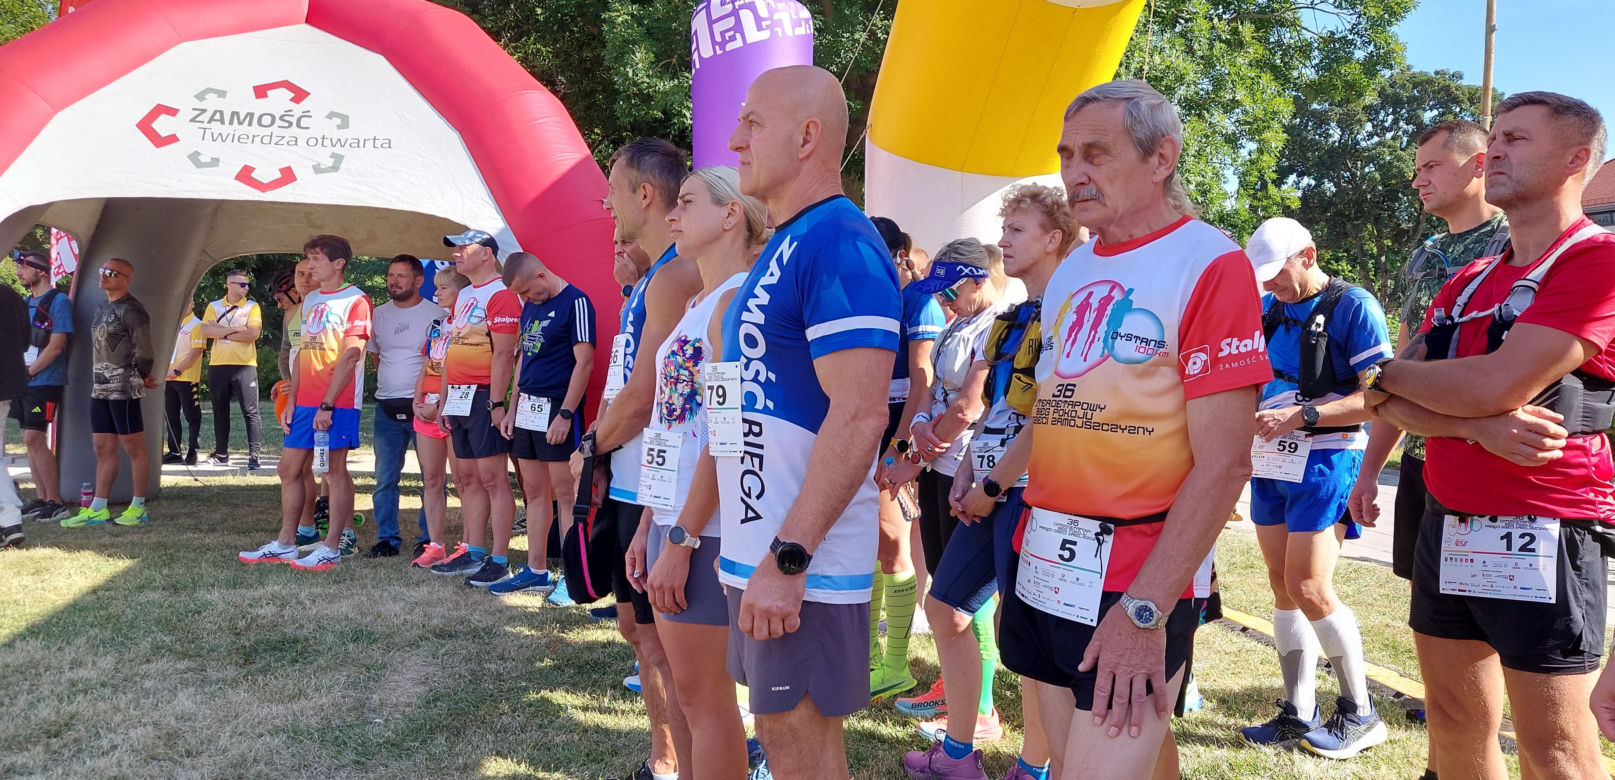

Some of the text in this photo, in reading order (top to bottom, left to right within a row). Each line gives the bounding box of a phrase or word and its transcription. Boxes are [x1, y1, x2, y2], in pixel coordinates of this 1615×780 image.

[189, 107, 312, 130] ZAMOŚĆ
[197, 127, 392, 149] Twierdza otwarta
[739, 234, 798, 412] ZAMOŚĆ
[1111, 331, 1168, 350] DYSTANS:
[1219, 355, 1257, 370] ZAMOŚĆ
[459, 391, 470, 399] 28
[707, 384, 727, 407] 79
[1052, 383, 1077, 399] 36
[530, 403, 544, 413] 65
[1052, 408, 1094, 421] POKOJU
[1051, 416, 1155, 436] ZAMOJSZCZYZNY
[1277, 440, 1299, 454] 59
[646, 447, 667, 467] 55
[977, 454, 996, 469] 78
[740, 417, 766, 525] BIEGA
[1058, 538, 1078, 562] 5
[1500, 531, 1537, 553] 12
[911, 699, 947, 709] BROOKS
